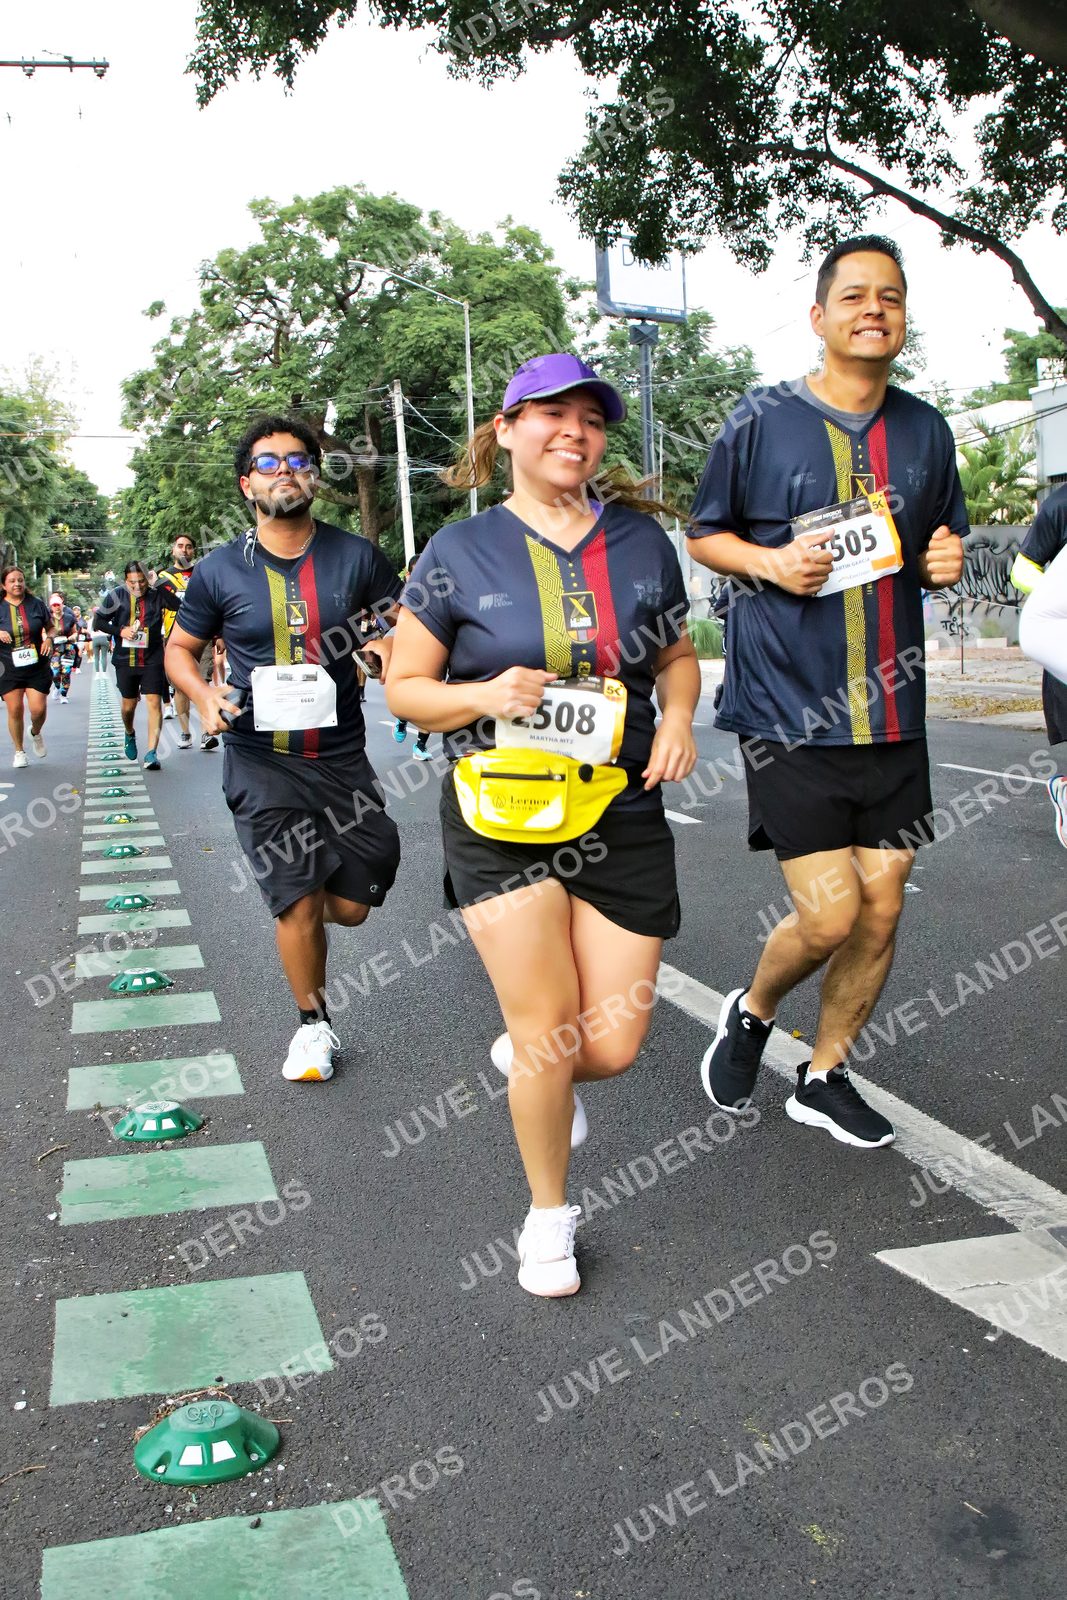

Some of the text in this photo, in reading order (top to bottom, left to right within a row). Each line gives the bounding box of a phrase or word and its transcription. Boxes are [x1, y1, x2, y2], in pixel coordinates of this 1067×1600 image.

[810, 525, 877, 562] 505
[529, 734, 558, 743] MARTHA
[510, 795, 550, 806] Lernen
